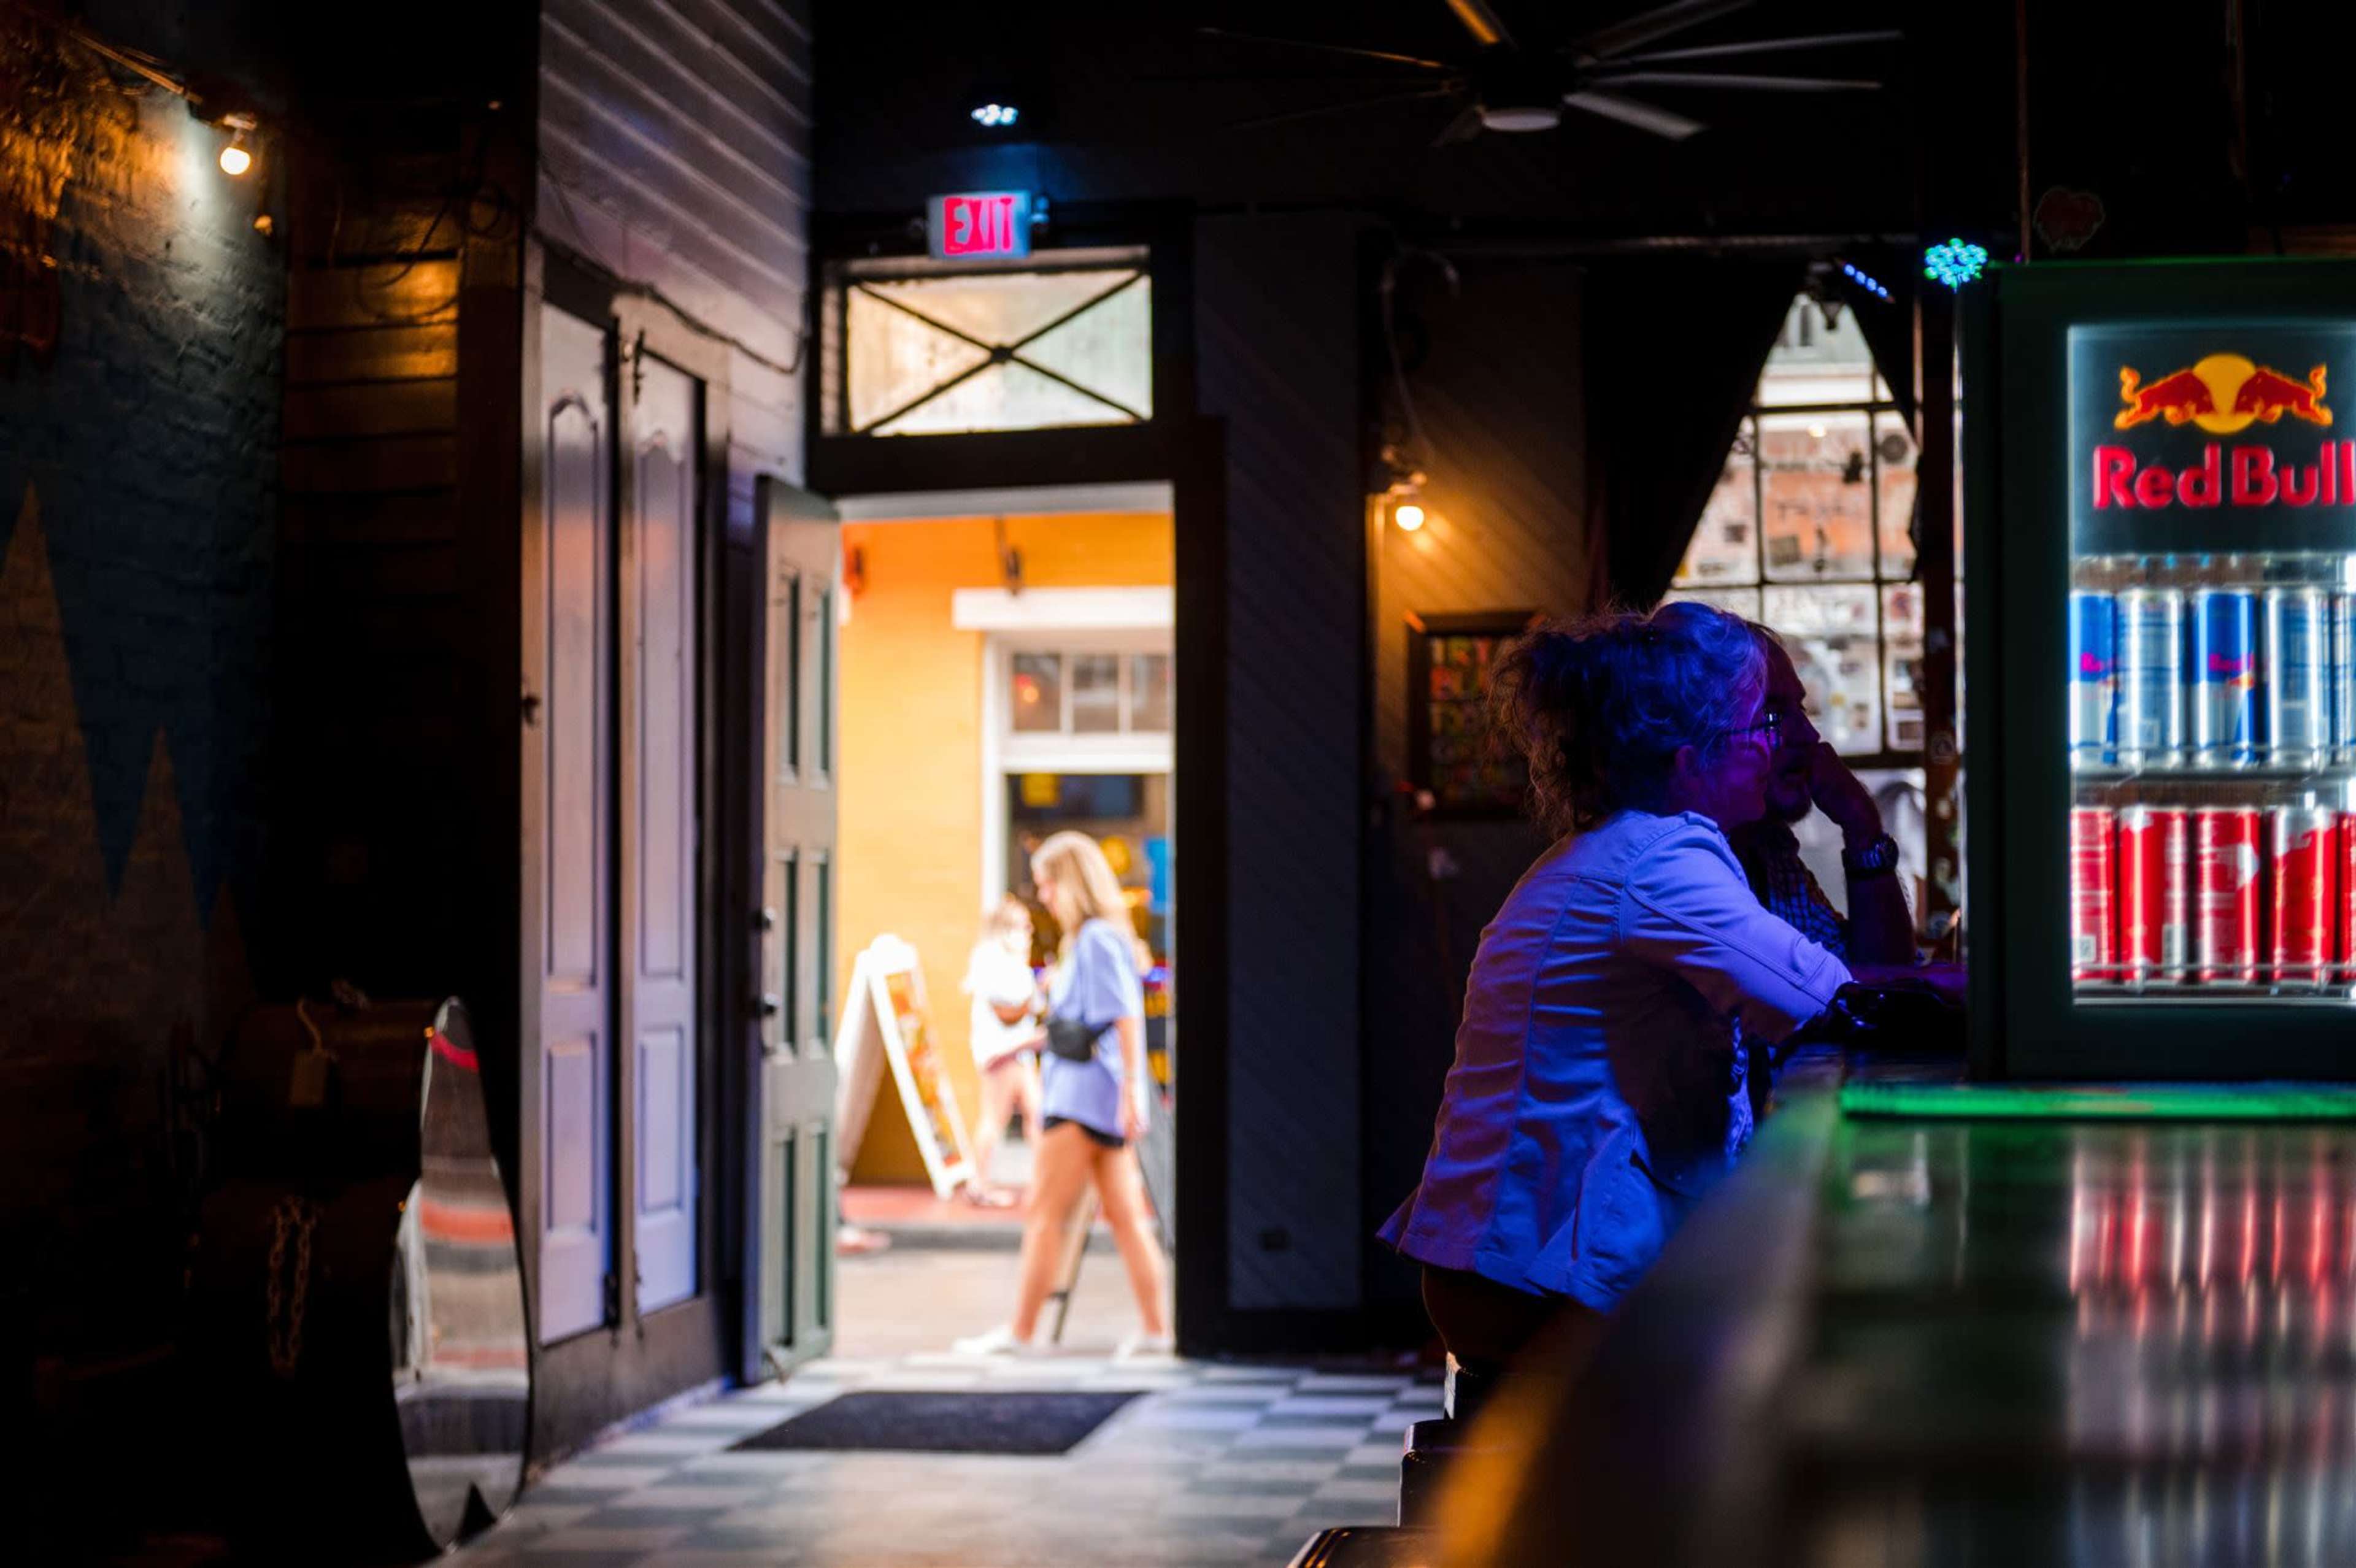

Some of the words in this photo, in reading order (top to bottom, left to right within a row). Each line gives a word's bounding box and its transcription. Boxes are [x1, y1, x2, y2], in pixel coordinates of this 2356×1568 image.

[944, 196, 1015, 255] EXIT
[2093, 441, 2222, 509] Red
[2232, 439, 2356, 507] Bull
